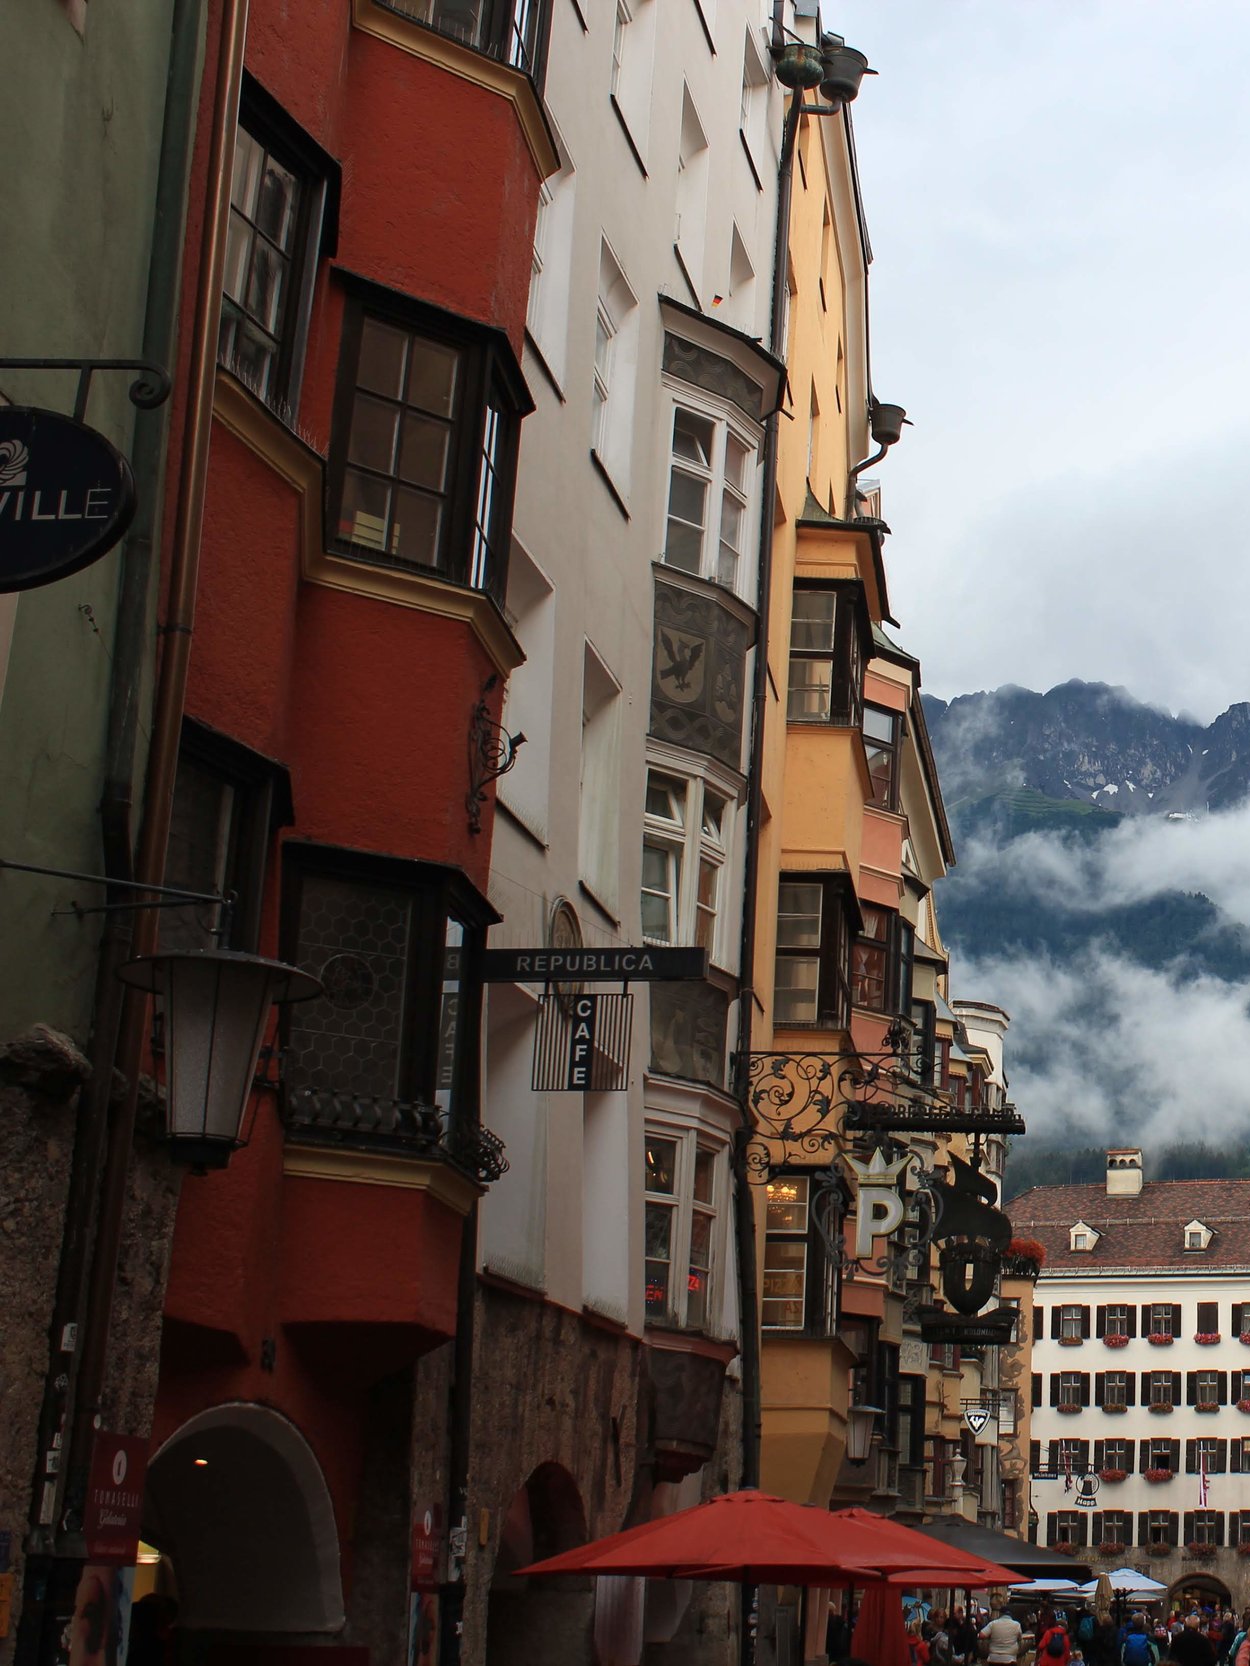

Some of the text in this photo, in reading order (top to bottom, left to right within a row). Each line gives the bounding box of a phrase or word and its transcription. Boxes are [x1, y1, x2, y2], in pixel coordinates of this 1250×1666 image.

[516, 954, 654, 972] REPUBLICA
[571, 1000, 593, 1085] CAFE
[856, 1187, 904, 1258] P
